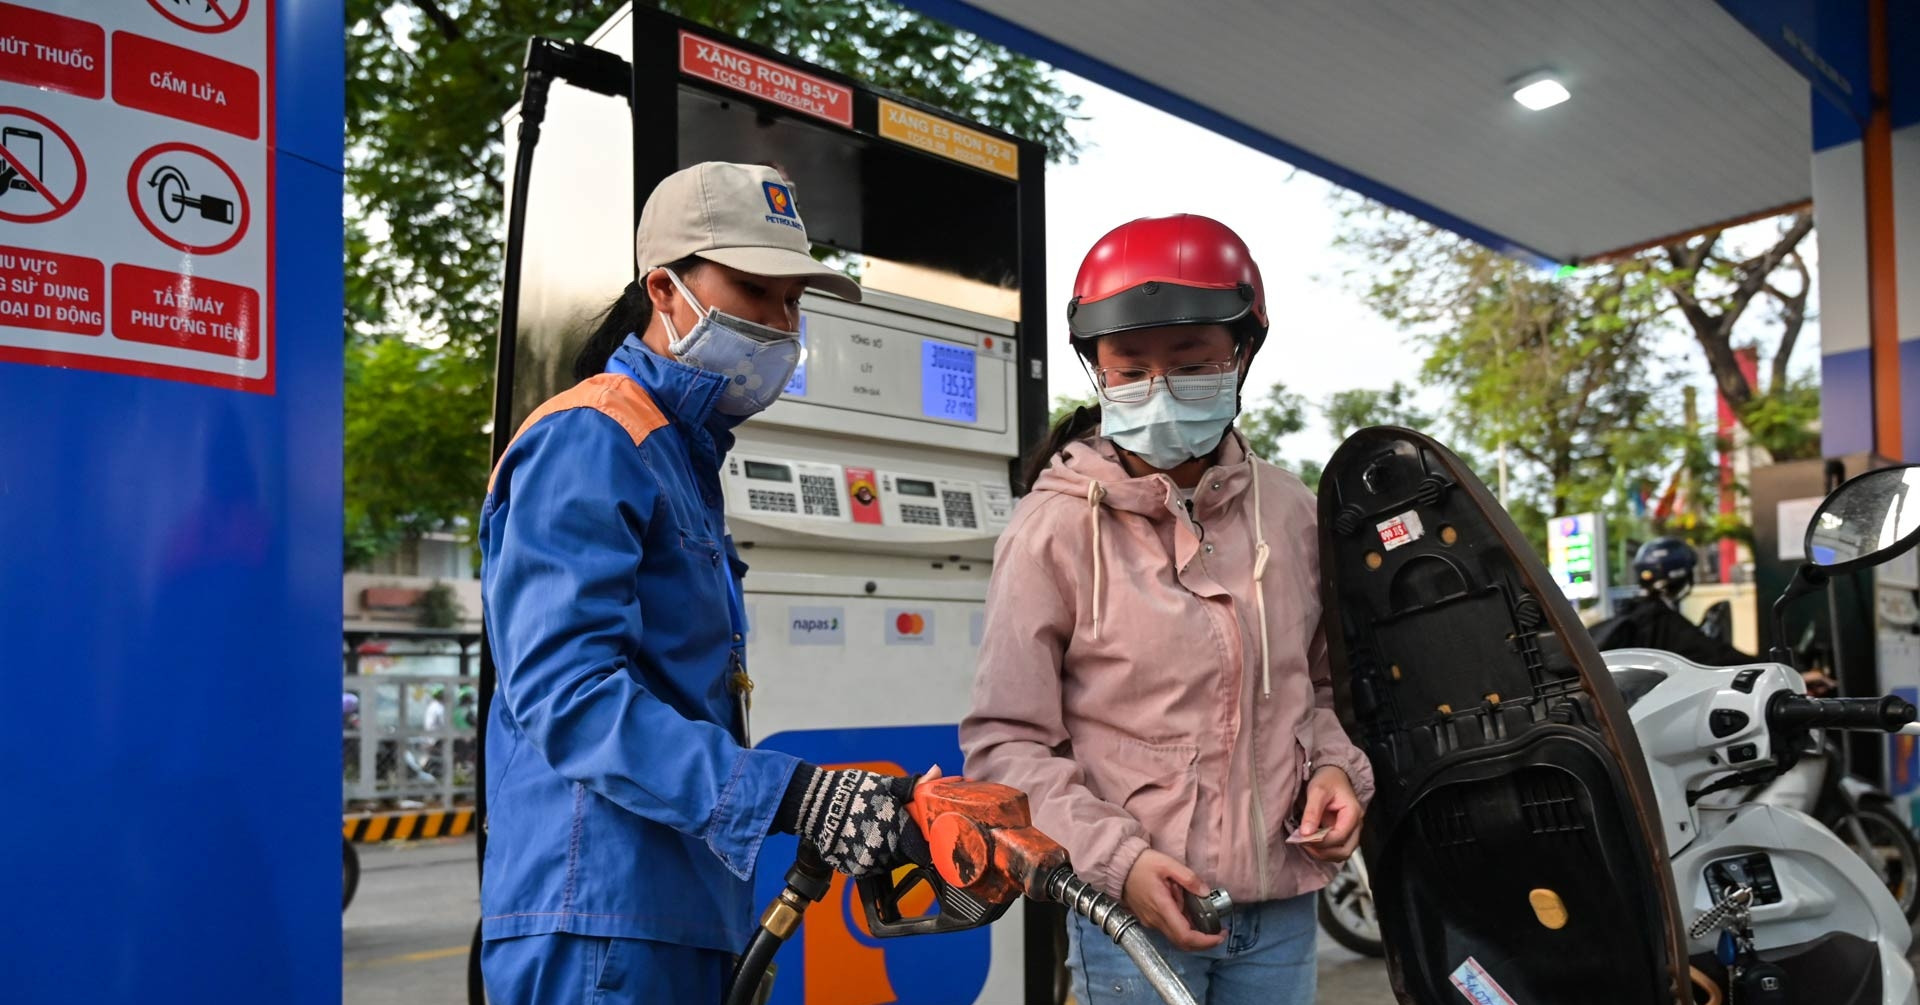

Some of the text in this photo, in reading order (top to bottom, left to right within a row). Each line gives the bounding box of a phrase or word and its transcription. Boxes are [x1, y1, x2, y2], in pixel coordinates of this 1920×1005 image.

[34, 44, 94, 71] THUỐC
[696, 44, 839, 105] XĂNG RON 95-V
[712, 67, 746, 88] TCCS
[149, 71, 227, 106] CẤM LỬA
[20, 256, 57, 276] VỰC
[11, 276, 38, 294] SỬ
[44, 282, 89, 301] DỤNG
[153, 285, 224, 316] TẮT MÁY
[35, 304, 51, 319] DI
[56, 305, 102, 325] ĐỘNG
[131, 309, 244, 342] PHƯƠNG TIỆN
[793, 619, 829, 632] napas
